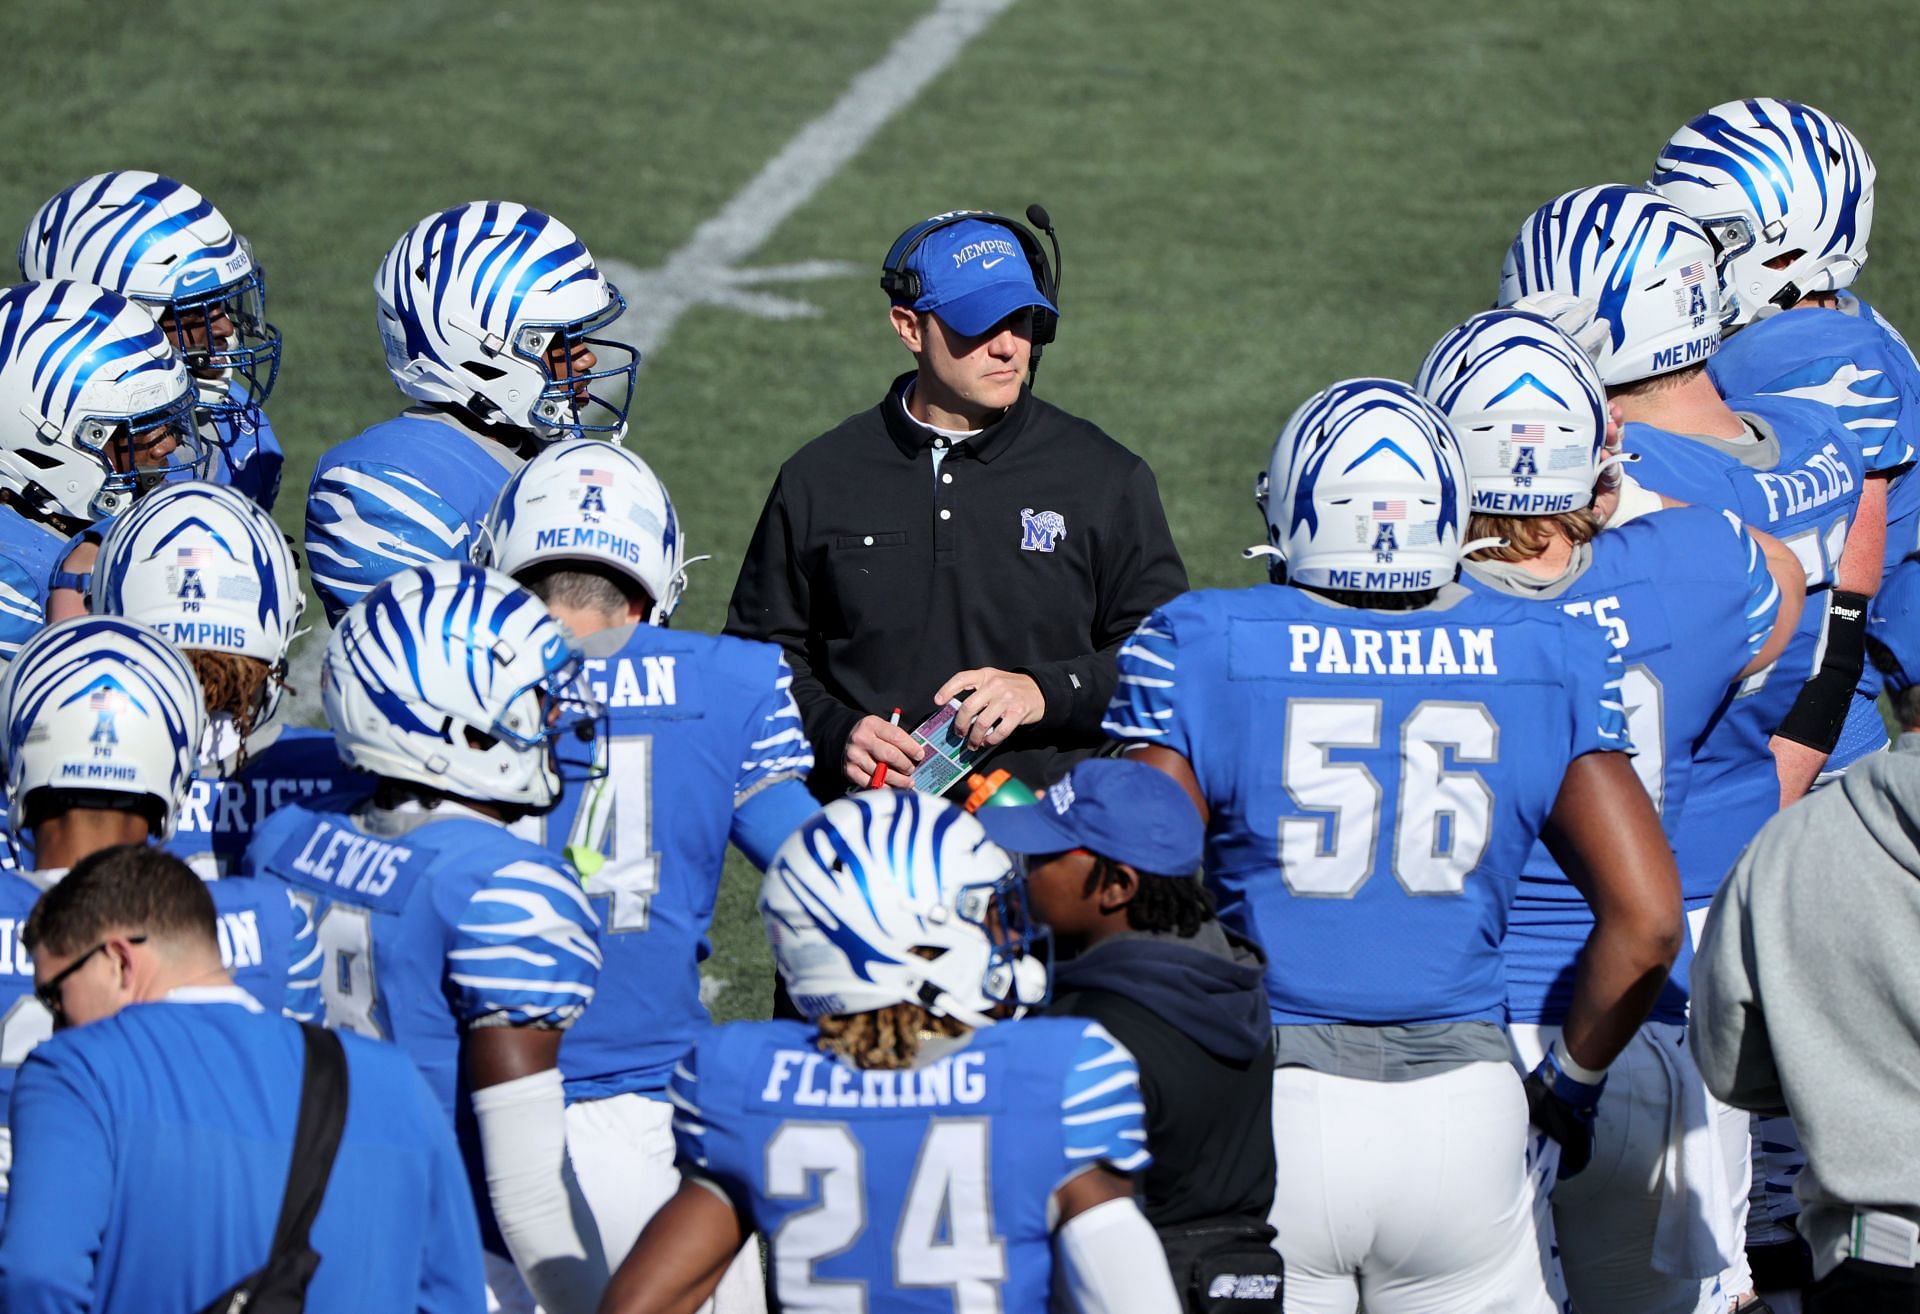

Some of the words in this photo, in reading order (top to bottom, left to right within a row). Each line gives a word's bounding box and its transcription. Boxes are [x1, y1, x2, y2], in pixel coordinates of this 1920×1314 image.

[953, 240, 1016, 268] MEMPHIS
[1472, 490, 1573, 512] MEMPHIS
[1753, 442, 1854, 523] FIELDS
[535, 528, 640, 564] MEMPHIS
[1328, 569, 1431, 589] MEMPHIS
[149, 622, 246, 648] EMPHIS
[1288, 624, 1497, 675] PARHAM
[62, 764, 136, 780] MEMPHIS
[1278, 697, 1500, 899] 56
[293, 821, 412, 896] LEWIS
[762, 1049, 986, 1108] FLEMING
[765, 1116, 1008, 1314] 24
